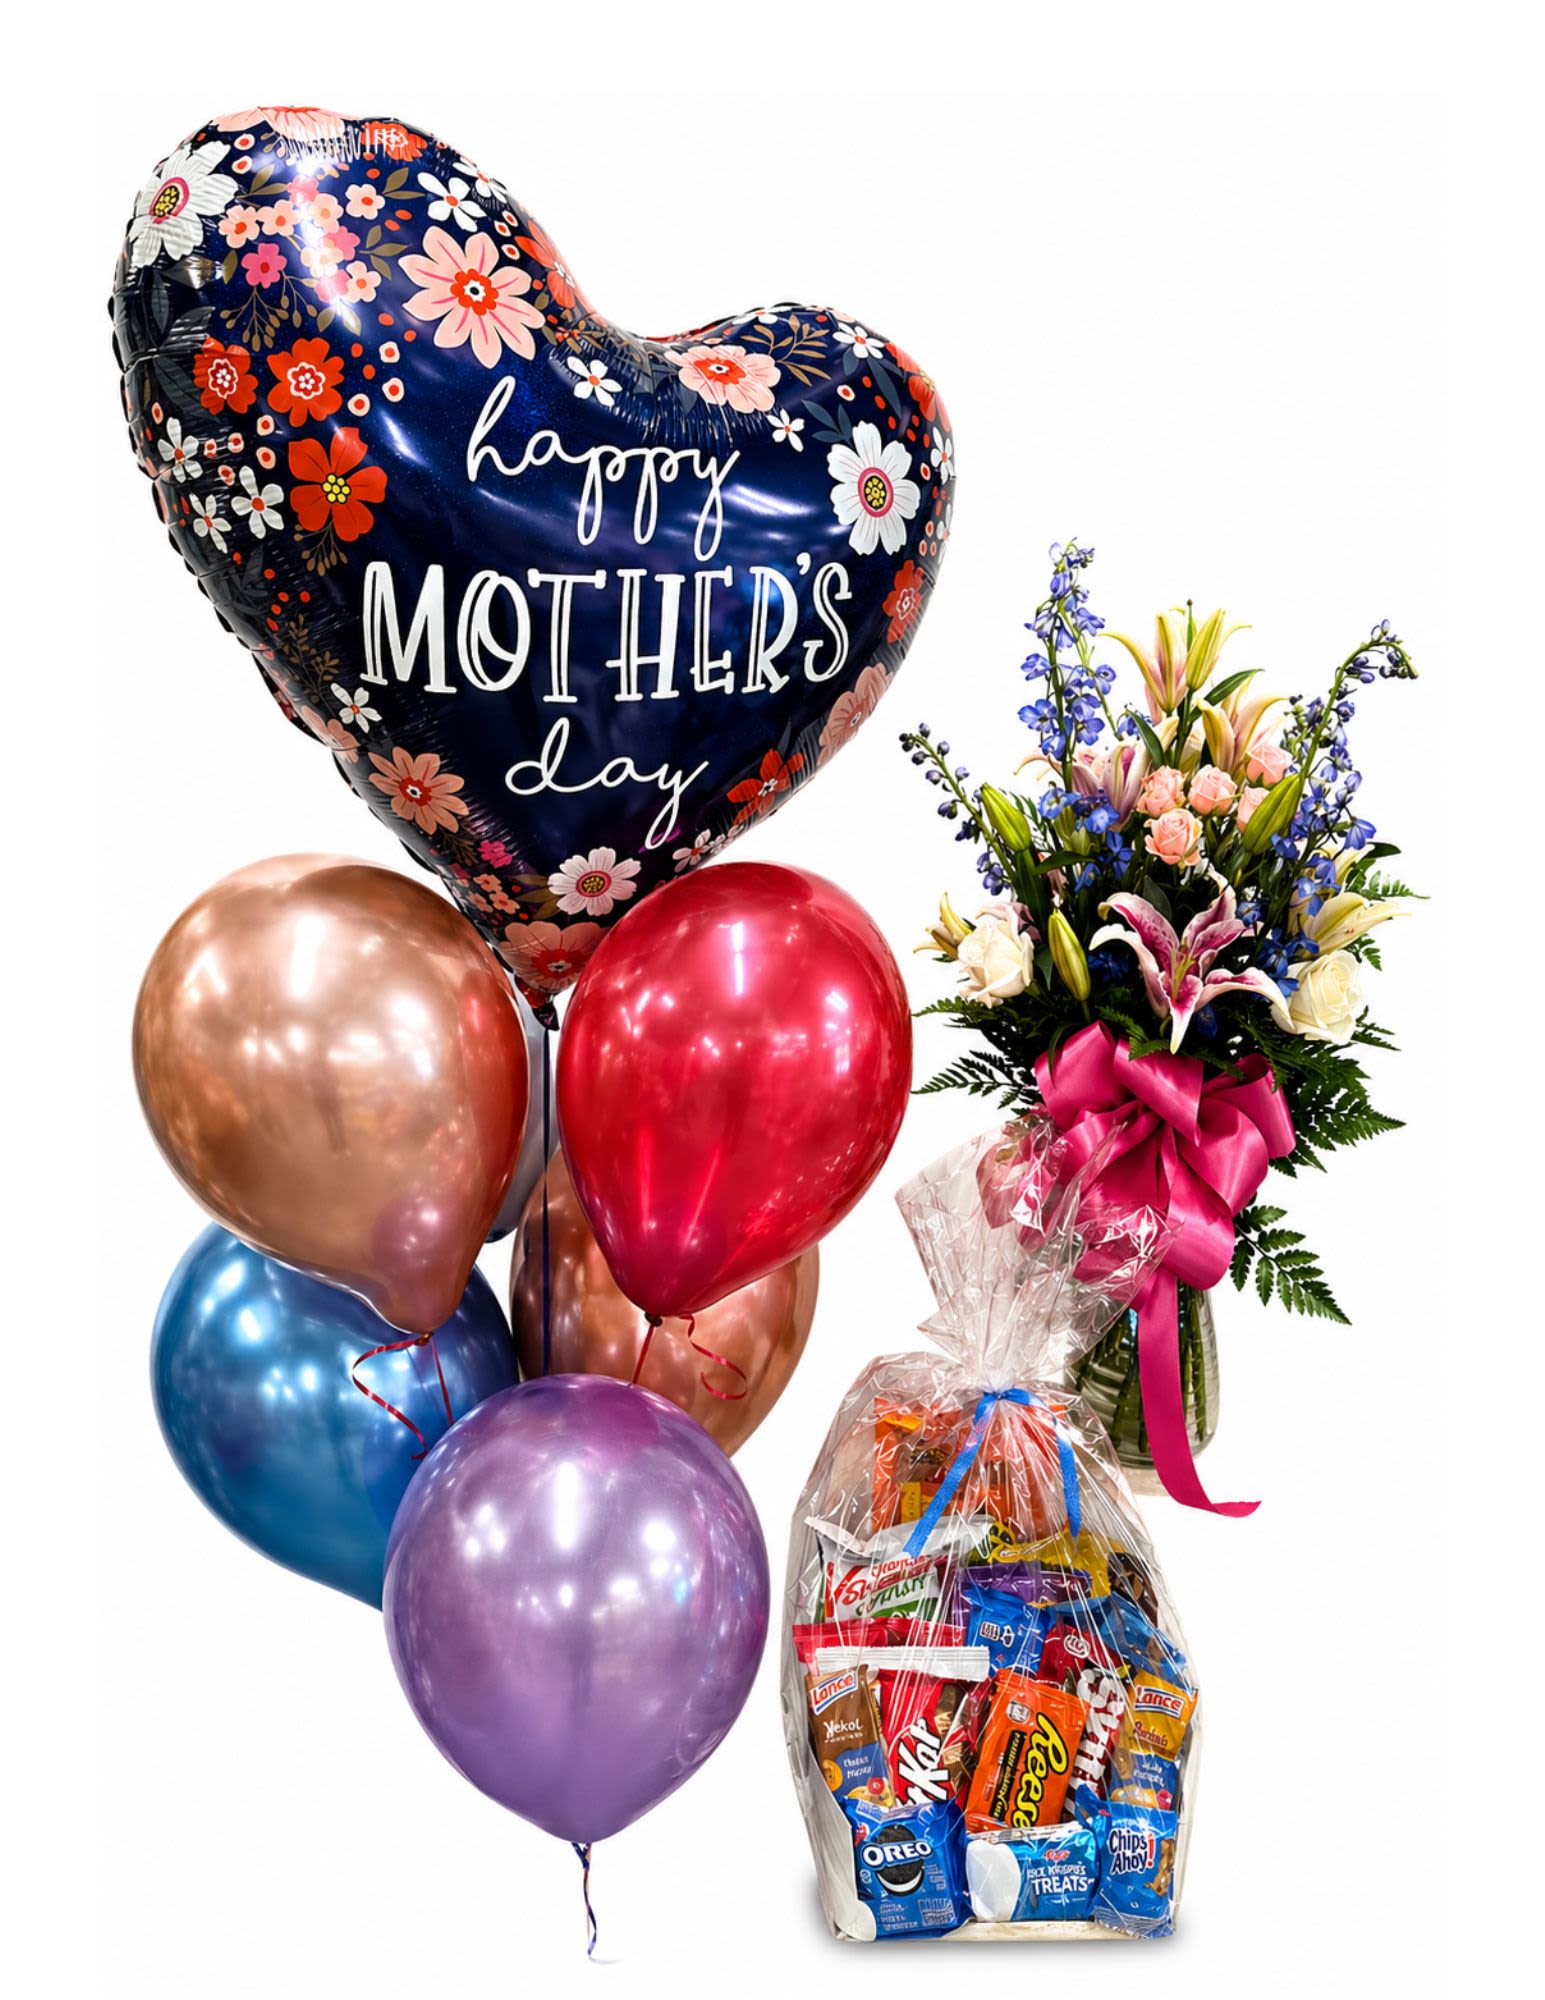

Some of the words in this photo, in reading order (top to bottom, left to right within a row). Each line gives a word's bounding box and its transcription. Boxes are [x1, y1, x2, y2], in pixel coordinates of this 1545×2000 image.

[466, 375, 741, 561] happy
[360, 552, 853, 702] MOTHER'S
[505, 717, 709, 851] day
[813, 1674, 854, 1705] Lance
[1136, 1685, 1182, 1711] Lance
[862, 1840, 933, 1867] OREO
[1109, 1829, 1148, 1853] Chips
[1031, 1875, 1089, 1896] TREATS
